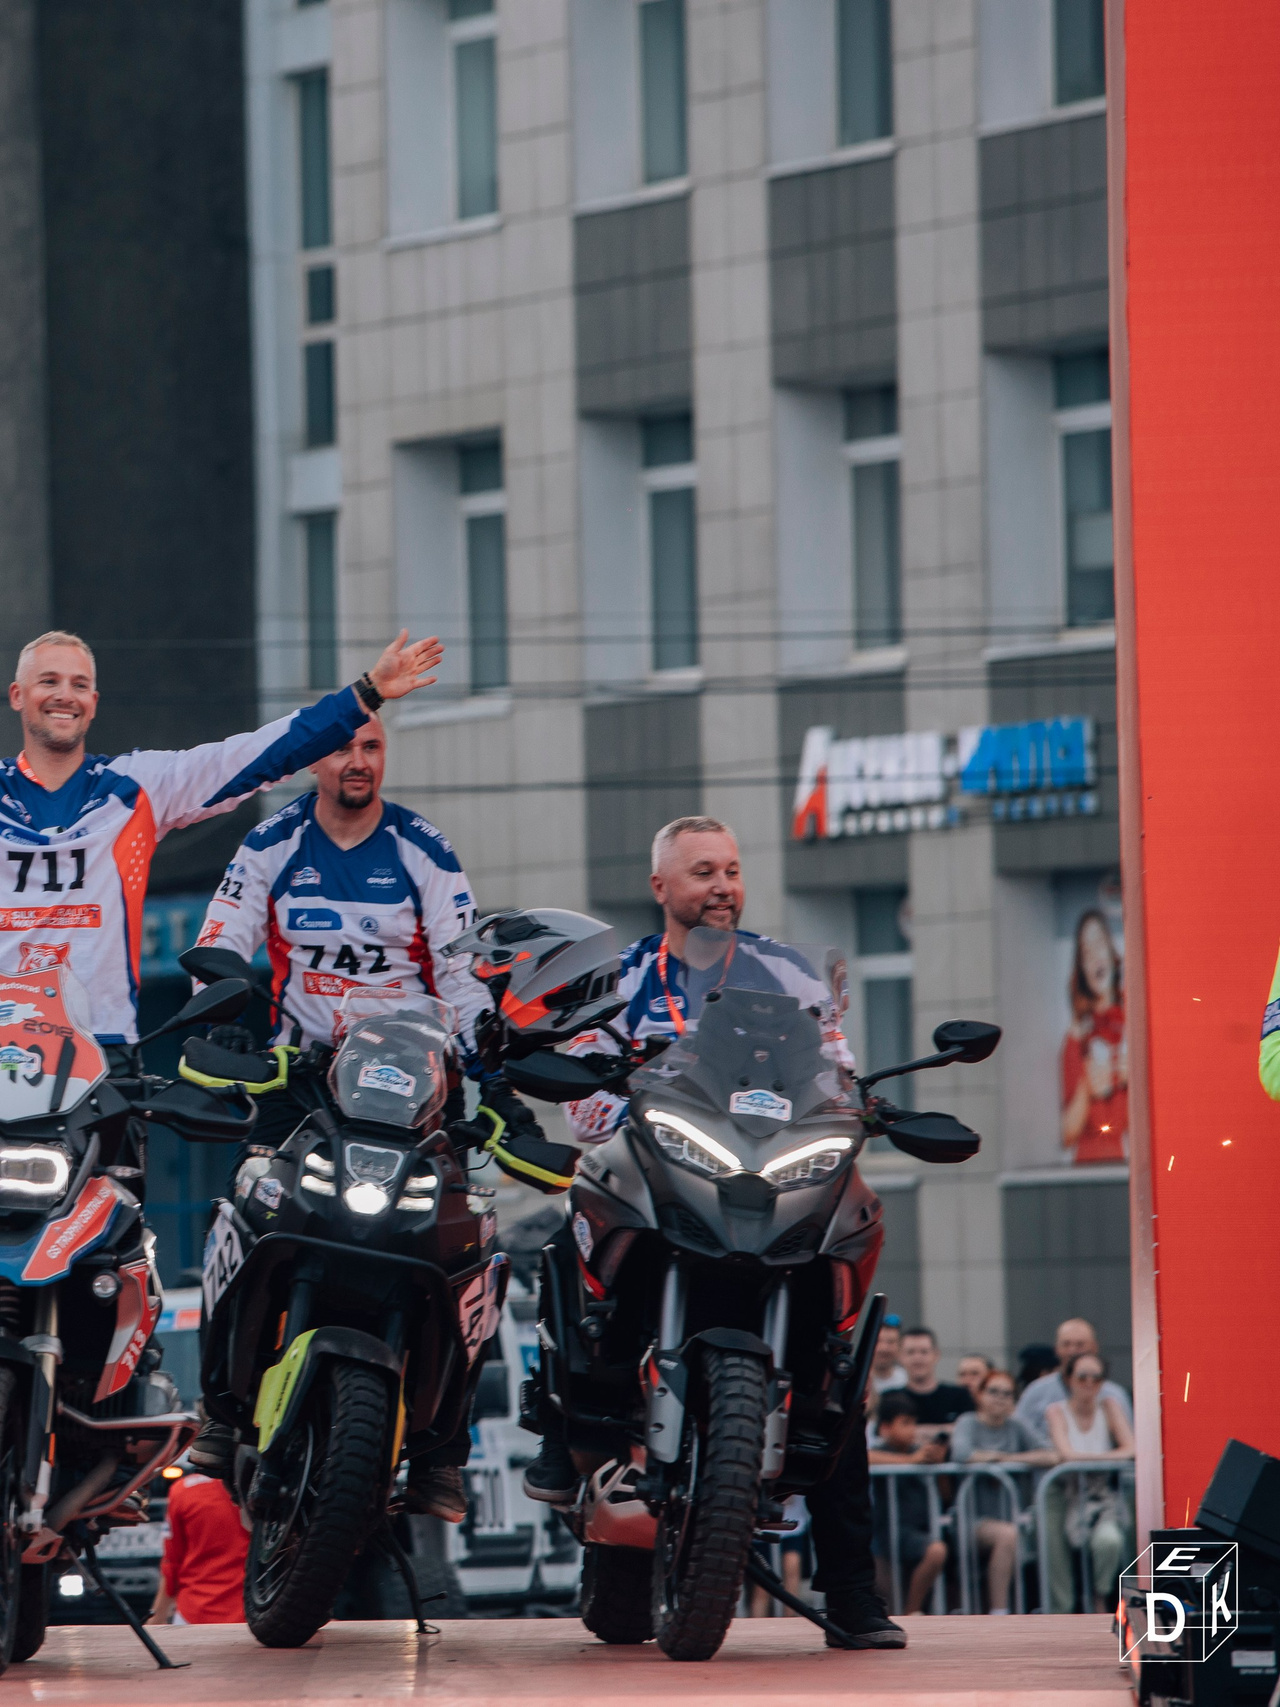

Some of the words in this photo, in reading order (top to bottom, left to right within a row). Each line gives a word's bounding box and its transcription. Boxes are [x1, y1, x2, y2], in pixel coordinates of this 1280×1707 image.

[7, 848, 86, 892] 711
[11, 911, 36, 919] SILK
[301, 944, 392, 975] 742
[319, 976, 344, 986] SILK
[46, 1244, 62, 1259] GS
[55, 1219, 84, 1249] TROPHY
[207, 1231, 239, 1302] 742
